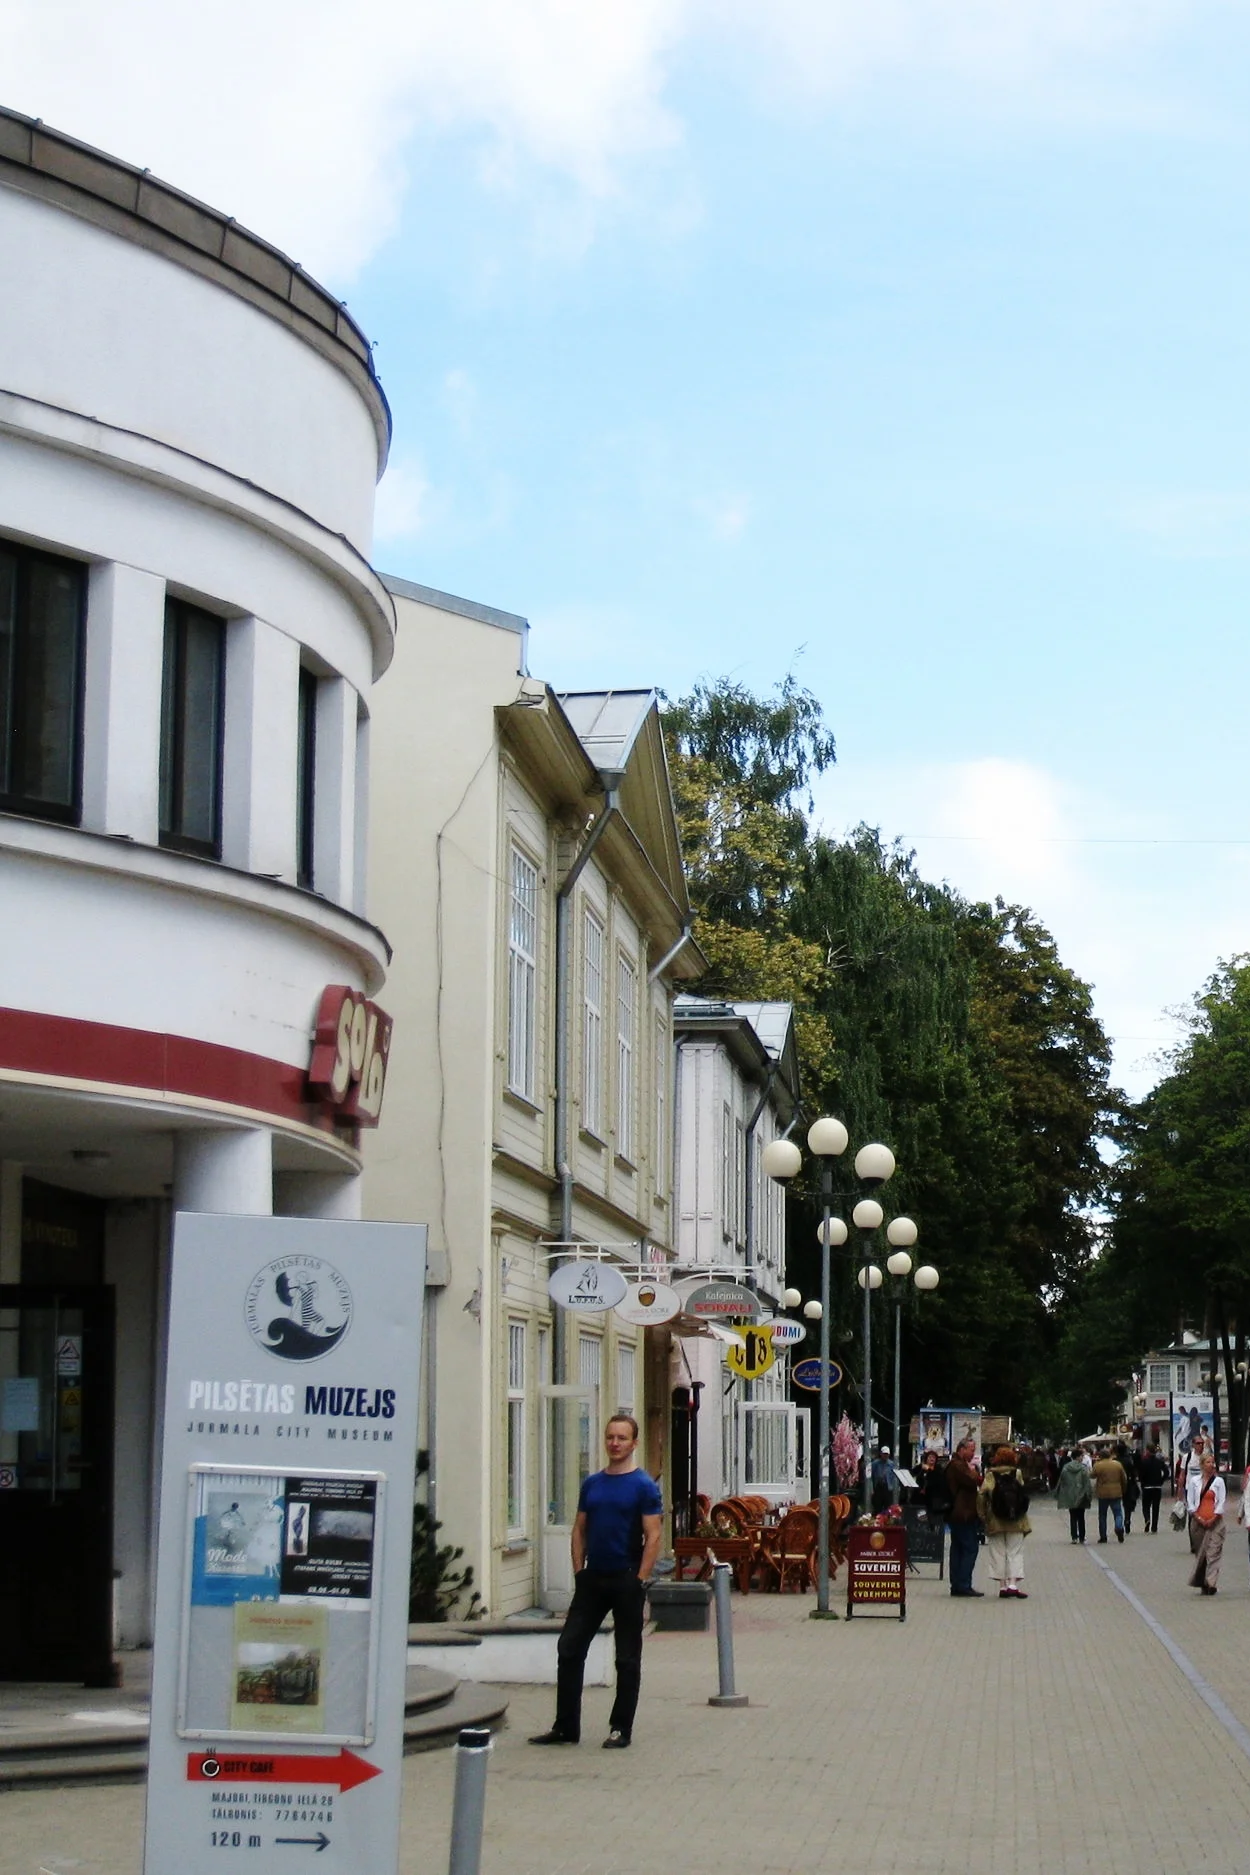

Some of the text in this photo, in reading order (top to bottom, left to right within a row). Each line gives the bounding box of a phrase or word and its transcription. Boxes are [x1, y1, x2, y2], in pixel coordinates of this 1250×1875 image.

[188, 1379, 396, 1418] PILSĒTAS MUZEJS
[276, 1426, 311, 1438] CITY
[327, 1428, 393, 1442] MUSEUM
[224, 1761, 247, 1773] CITY
[211, 1831, 261, 1848] 120 m
